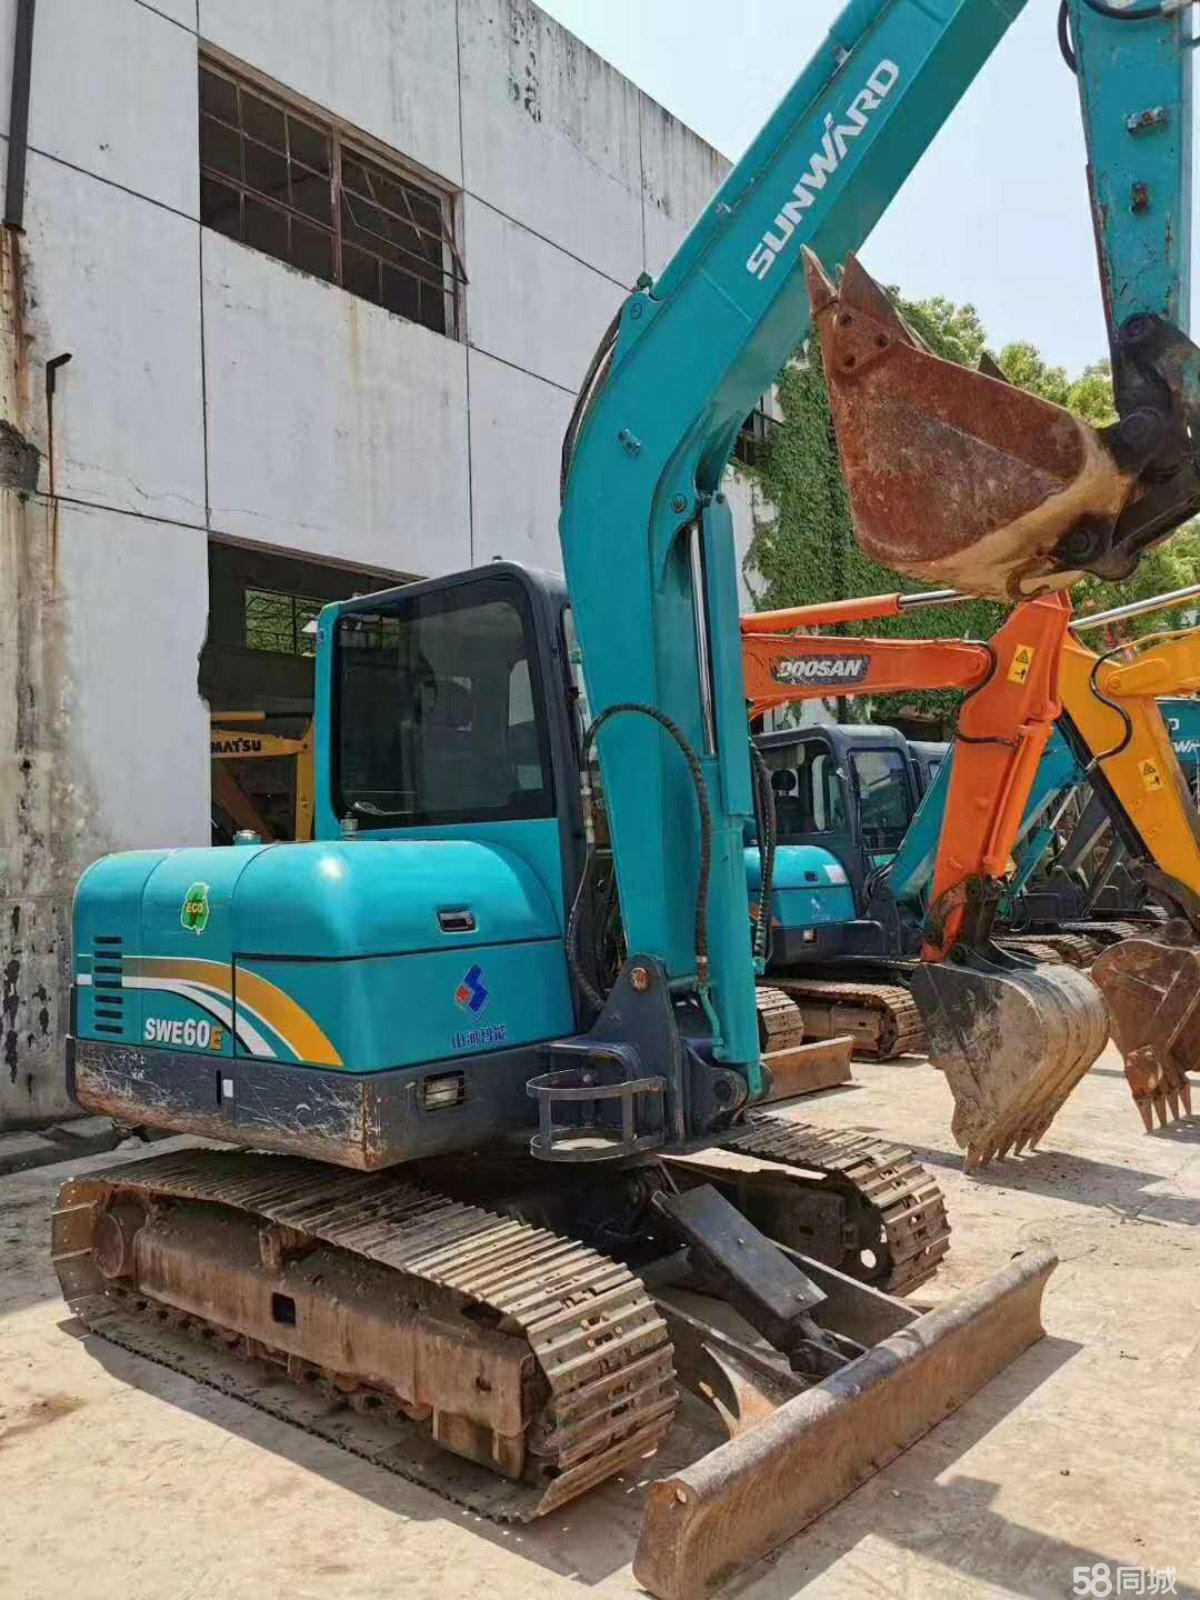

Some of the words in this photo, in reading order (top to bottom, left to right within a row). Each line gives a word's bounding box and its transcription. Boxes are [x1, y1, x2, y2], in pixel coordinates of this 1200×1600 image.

[746, 59, 899, 280] SUNWARD
[777, 660, 862, 677] DOOSAN
[186, 902, 203, 913] ECO
